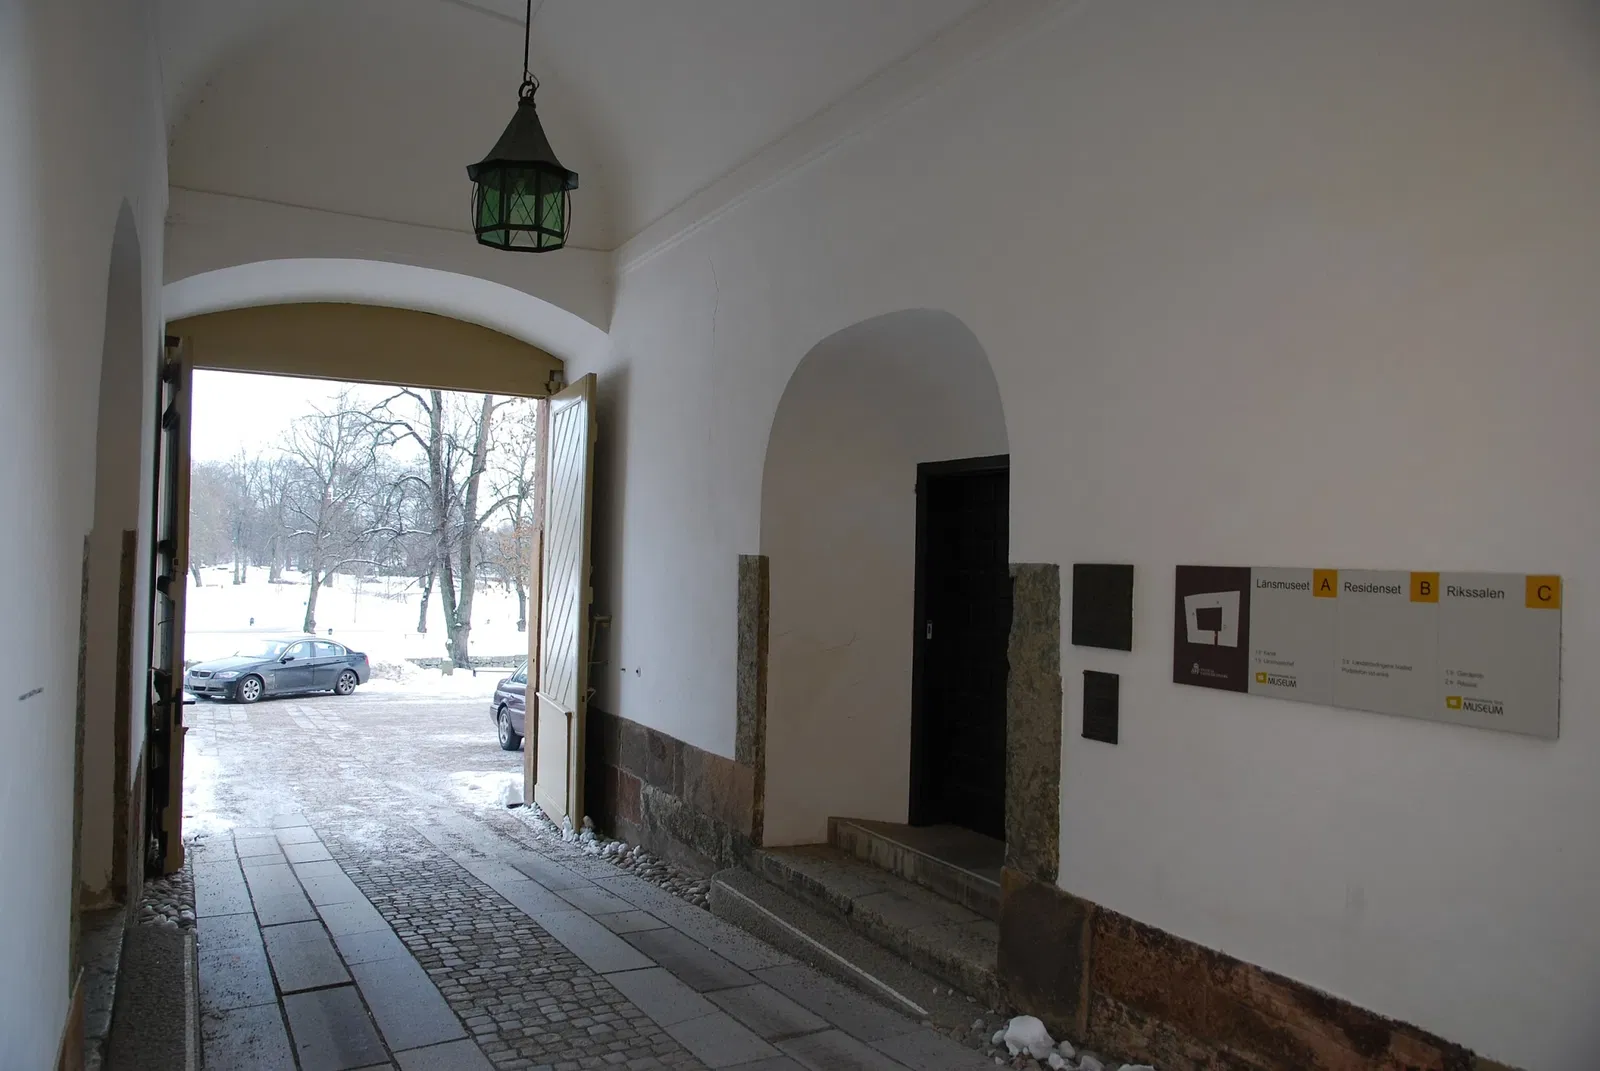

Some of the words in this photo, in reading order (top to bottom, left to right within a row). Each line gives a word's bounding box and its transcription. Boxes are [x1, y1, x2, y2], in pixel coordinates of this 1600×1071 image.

[1256, 578, 1310, 591] Länsmuseet
[1320, 578, 1331, 591] A
[1344, 581, 1402, 595] Residenset
[1420, 581, 1431, 595] B
[1447, 585, 1505, 599] Rikssalen
[1537, 585, 1552, 601] C
[1267, 677, 1297, 688] MUSEUM
[1463, 701, 1504, 716] MUSEUM
